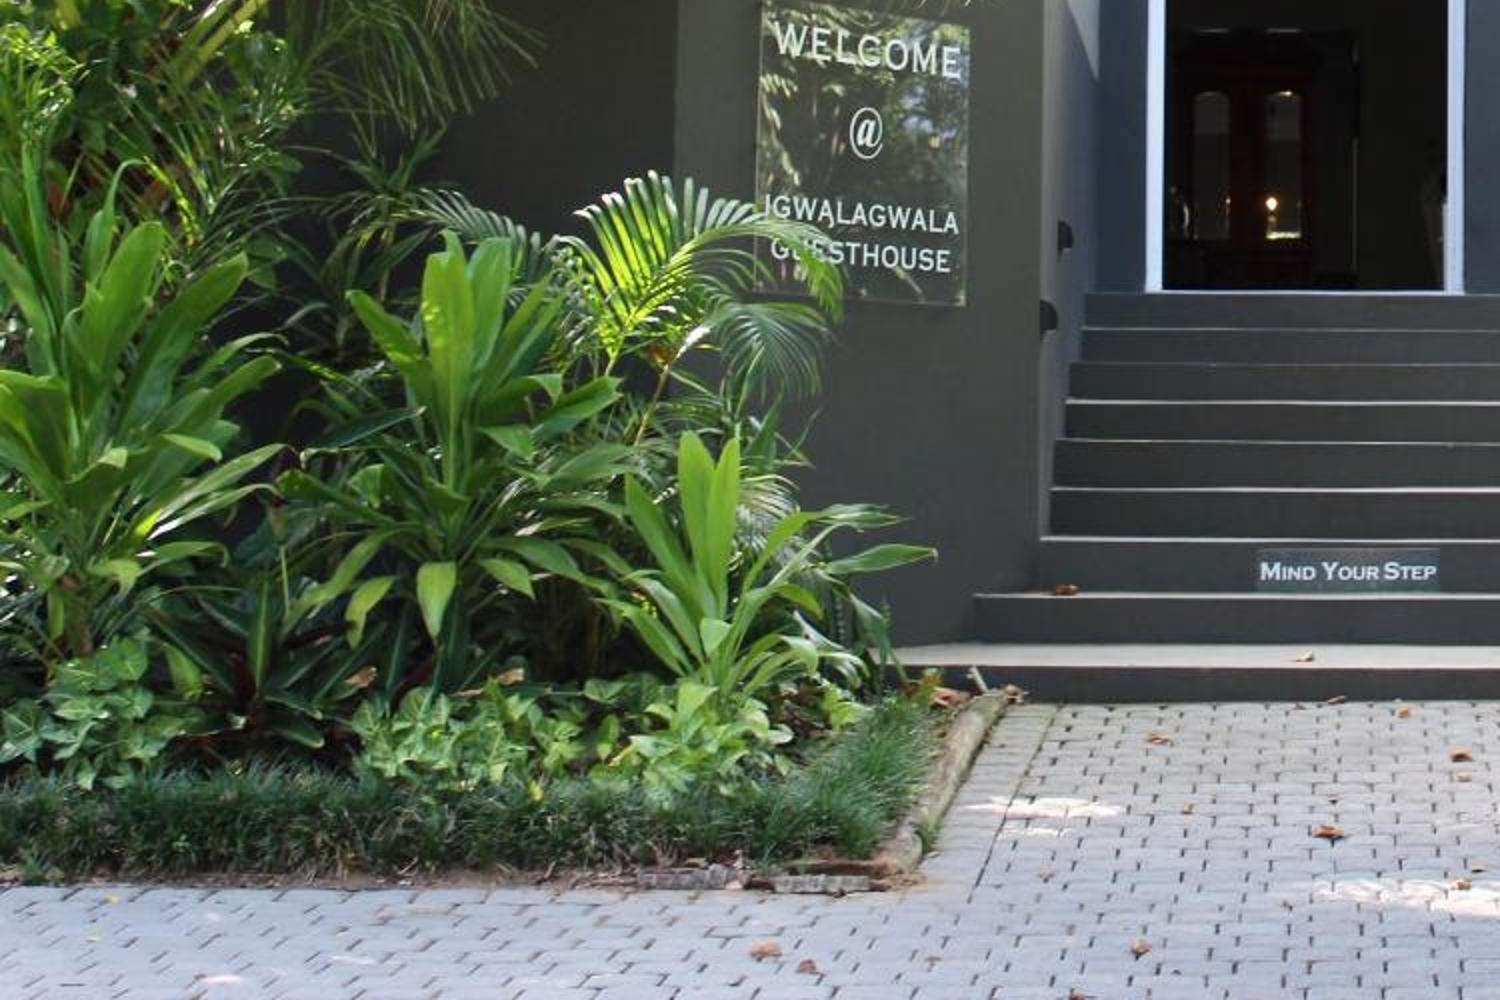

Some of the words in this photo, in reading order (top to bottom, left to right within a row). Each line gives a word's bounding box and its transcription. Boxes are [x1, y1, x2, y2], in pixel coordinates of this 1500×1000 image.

[774, 21, 962, 80] WELCOME
[850, 106, 883, 160] @
[764, 193, 960, 235] IGWALAGWALA
[1259, 561, 1316, 581] MIND
[1321, 561, 1380, 581] YOUR
[1383, 561, 1437, 581] STEP
